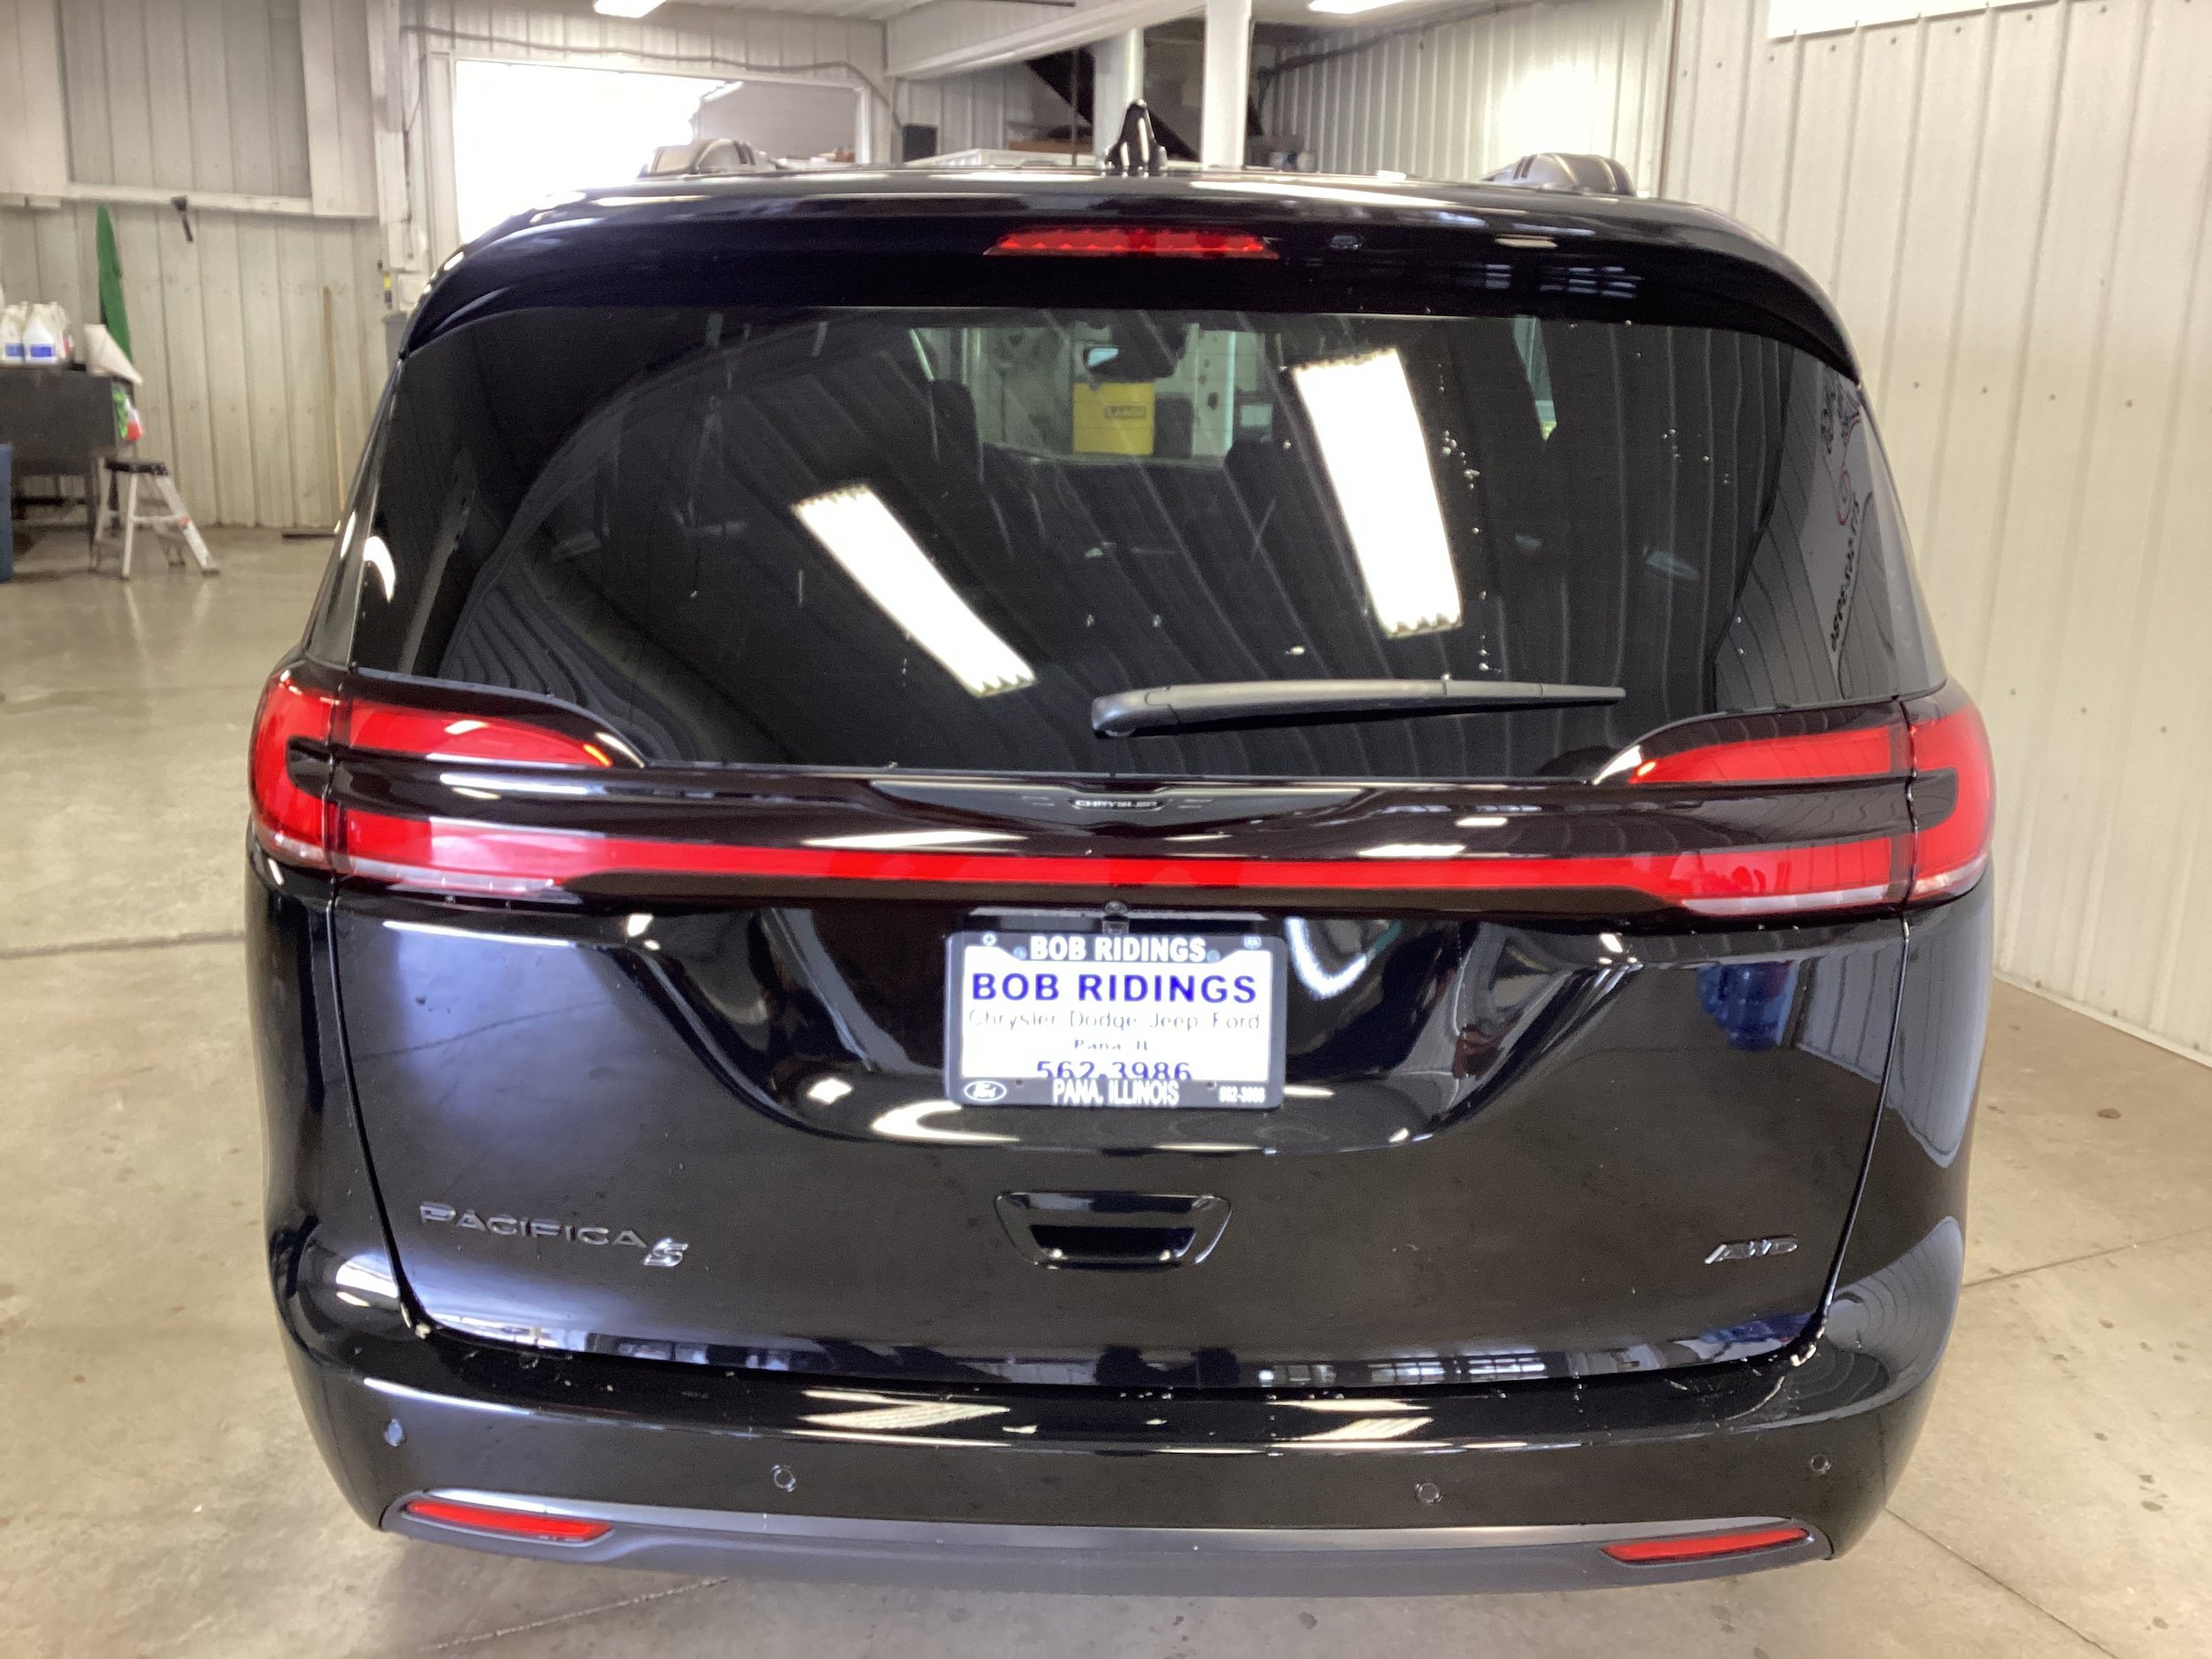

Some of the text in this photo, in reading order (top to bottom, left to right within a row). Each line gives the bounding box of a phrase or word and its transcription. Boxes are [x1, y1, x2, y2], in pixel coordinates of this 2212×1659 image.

[1030, 935, 1206, 963] BOB RIDINGS
[972, 972, 1257, 1003] BOB RIDINGS
[970, 1010, 1260, 1032] Chrysler Dodge Jeep Ford
[1108, 1079, 1180, 1105] ILLINOIS
[419, 1201, 648, 1248] PACIFICA
